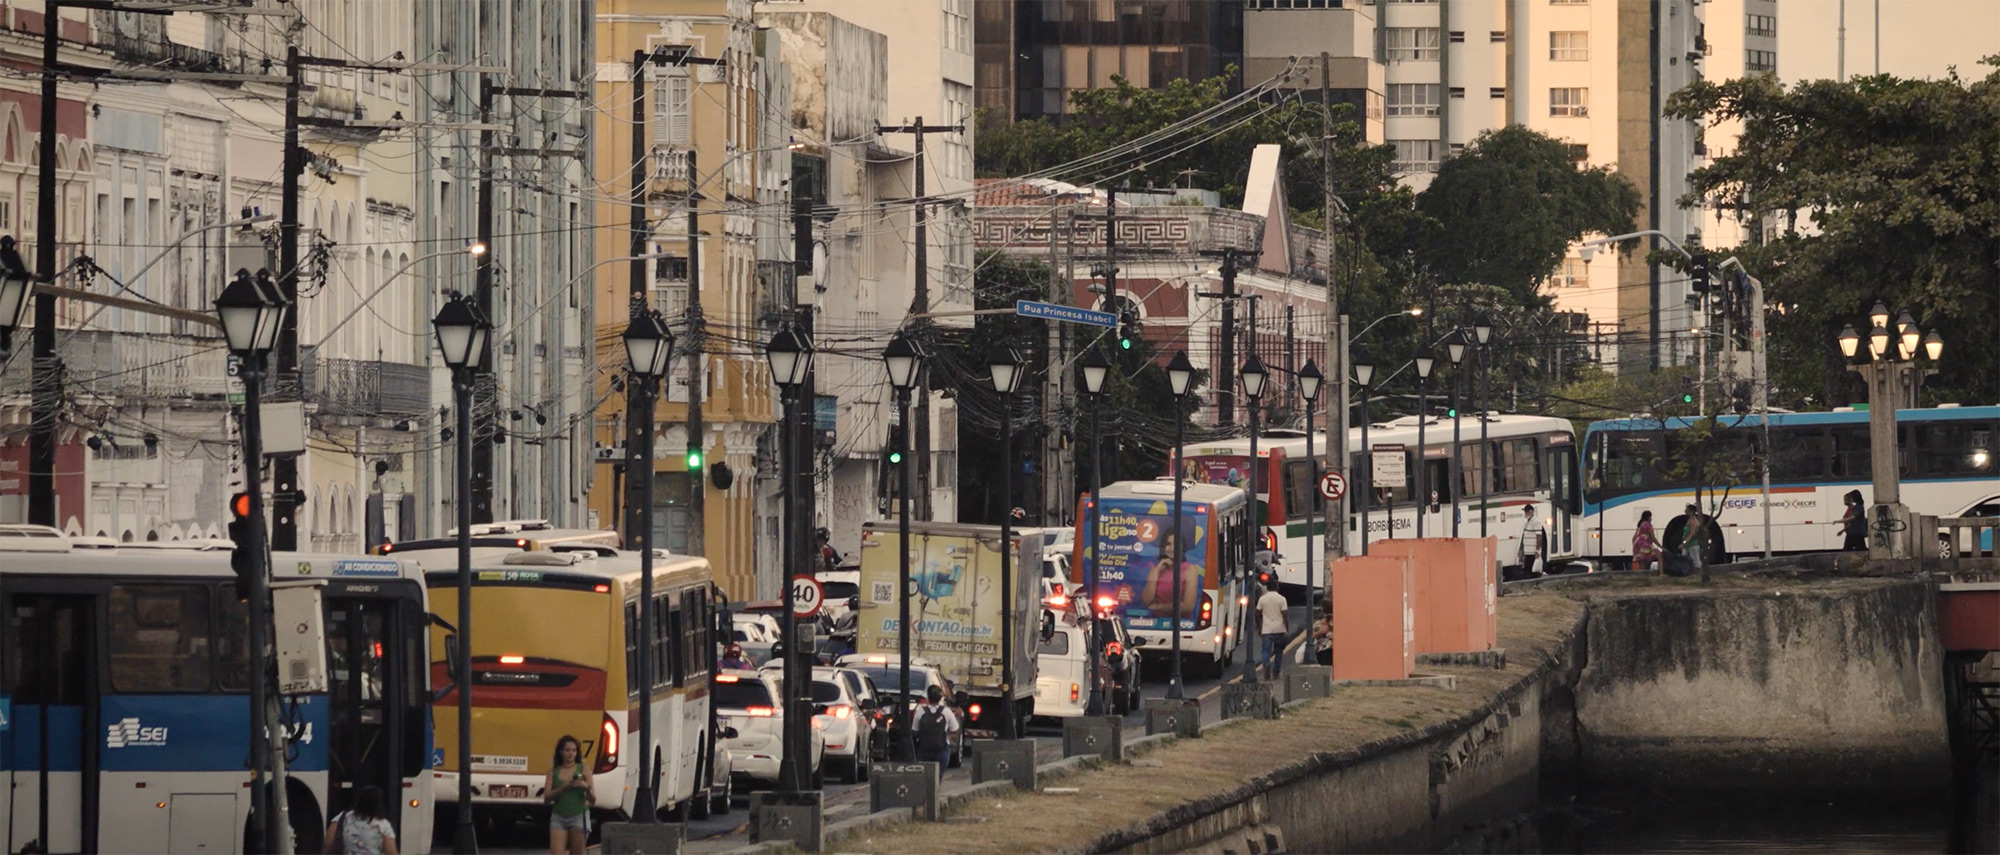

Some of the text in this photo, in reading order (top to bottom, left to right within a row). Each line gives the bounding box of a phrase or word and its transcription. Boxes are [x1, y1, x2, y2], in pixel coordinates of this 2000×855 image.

[1024, 305, 1112, 324] Rua Princesa Isabel
[1109, 516, 1138, 526] 11h40,
[1368, 519, 1411, 532] BORBREMA
[1142, 522, 1153, 538] 2
[1099, 571, 1124, 580] 1h40
[793, 585, 814, 602] 40
[883, 619, 992, 634] DEKONTAO.com.br
[925, 641, 953, 652] PEDIU,
[139, 727, 168, 741] SEI
